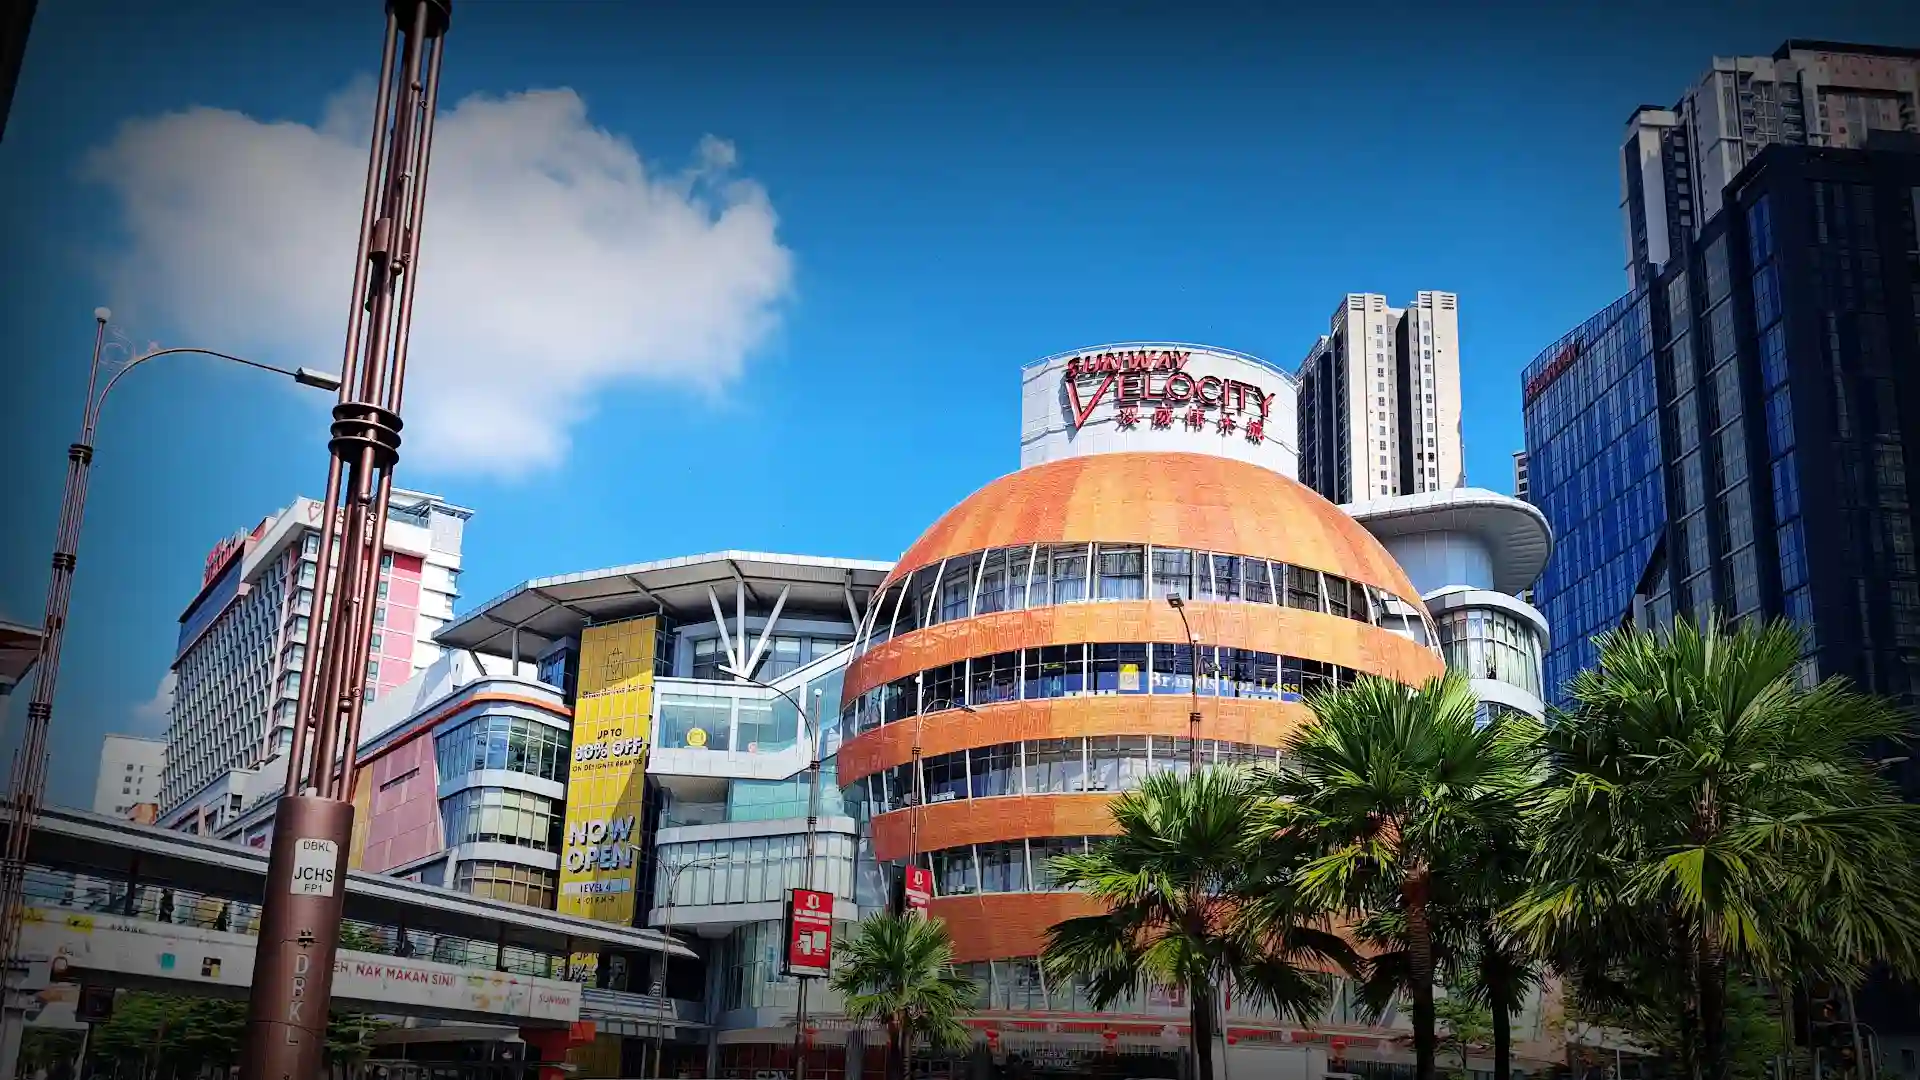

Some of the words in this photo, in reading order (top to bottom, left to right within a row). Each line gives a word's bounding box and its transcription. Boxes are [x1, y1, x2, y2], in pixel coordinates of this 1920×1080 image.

[1066, 350, 1191, 379] SUNWAY
[1065, 370, 1276, 431] VELOCITY
[597, 730, 608, 740] UP
[610, 728, 622, 737] TO
[612, 736, 643, 757] OFF
[568, 814, 636, 847] NOW
[303, 841, 332, 852] DBKL
[565, 840, 633, 874] OPEN
[294, 866, 334, 883] JCHS
[304, 883, 323, 893] FP1
[356, 964, 382, 977] NAK
[386, 967, 429, 984] MAKAN
